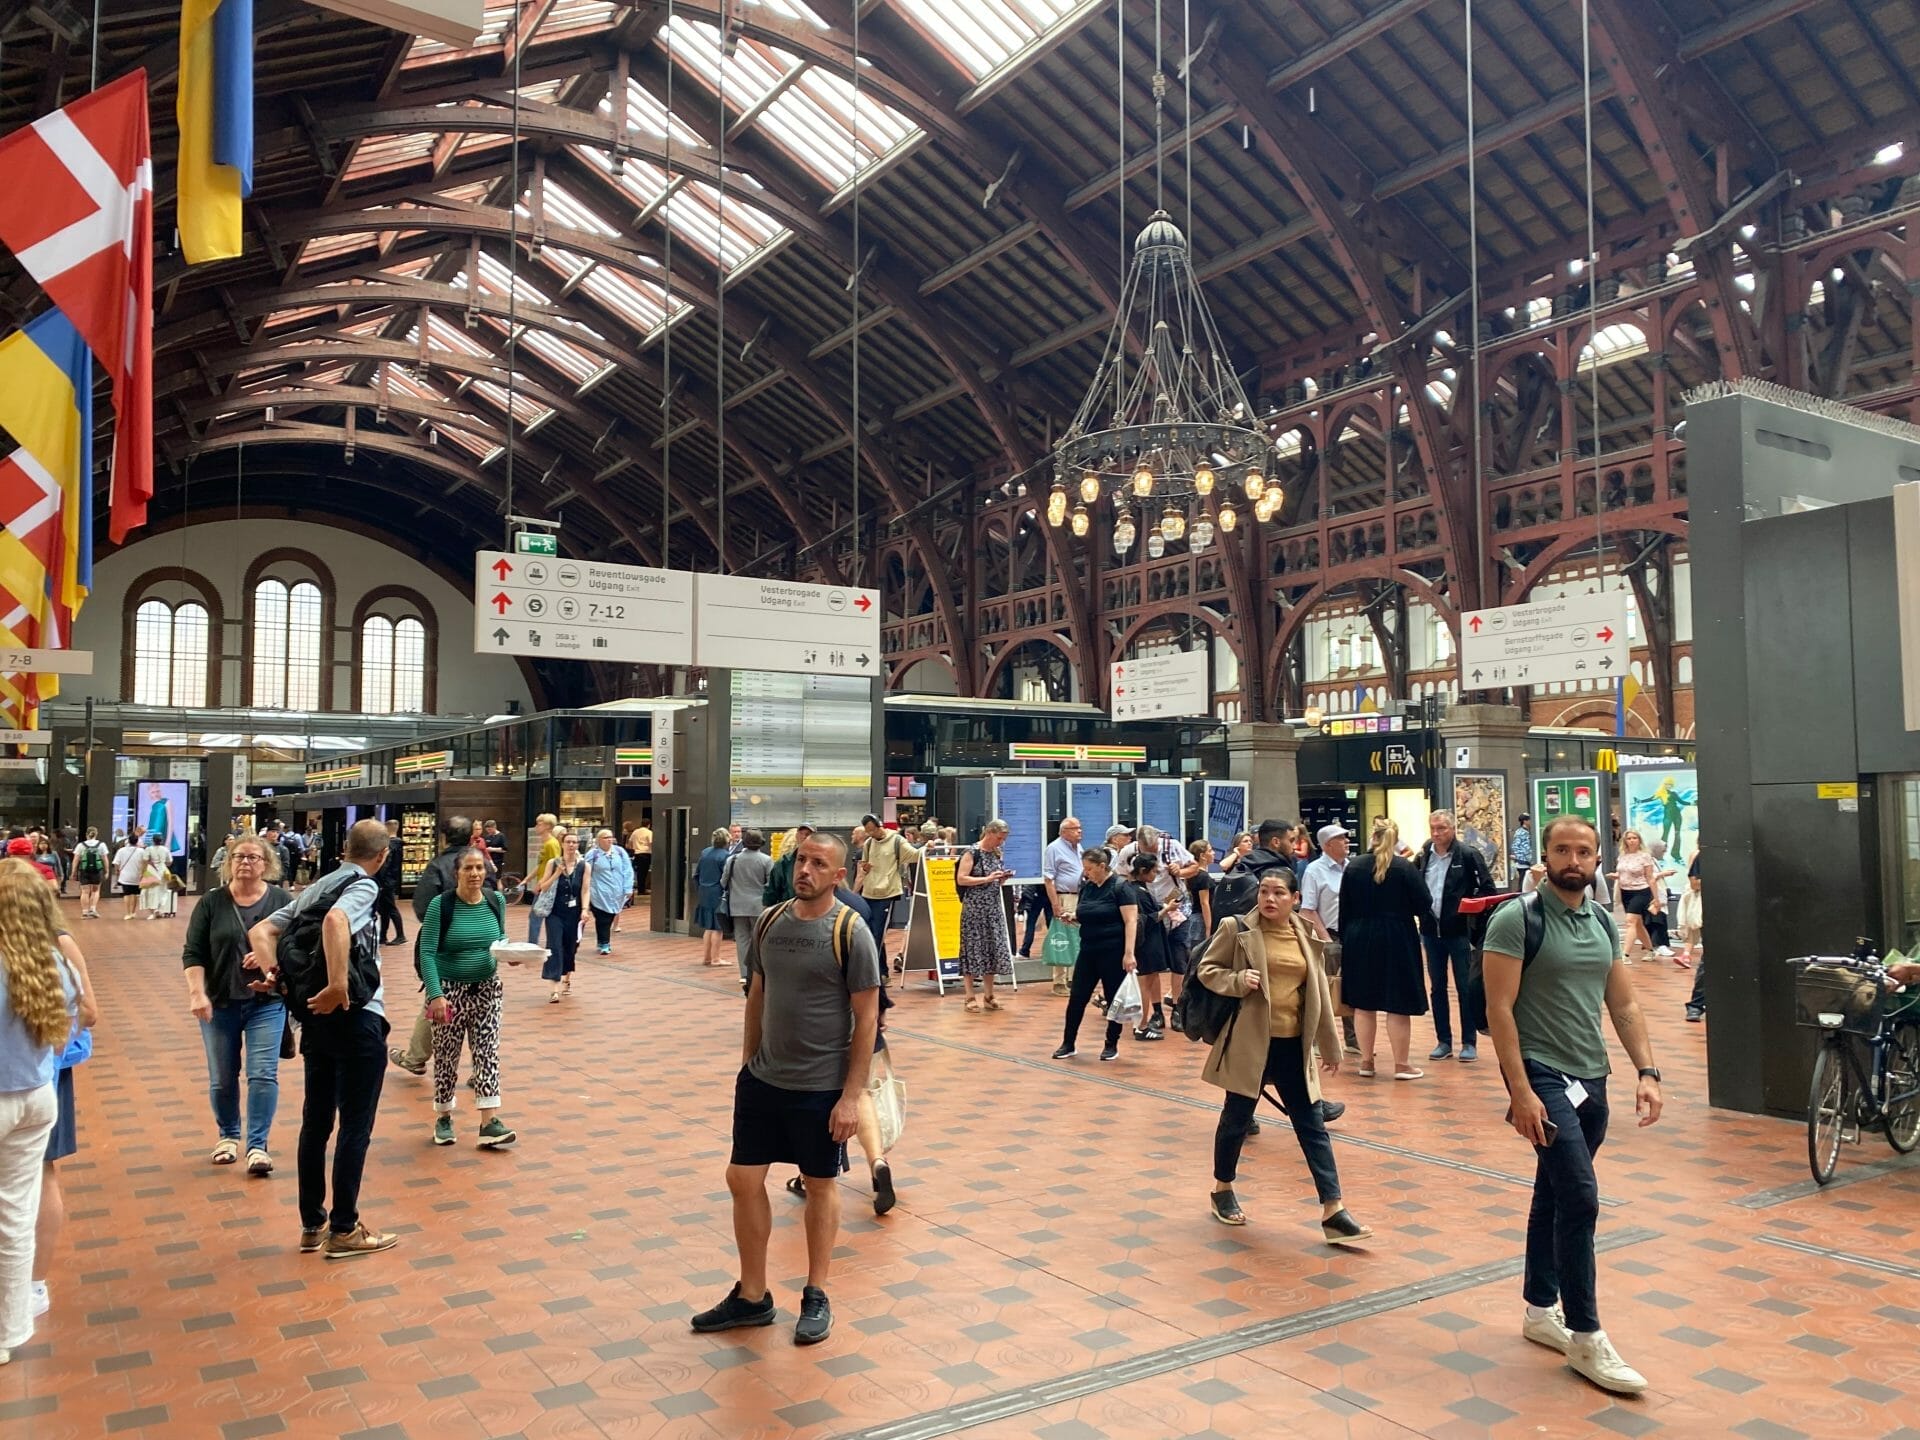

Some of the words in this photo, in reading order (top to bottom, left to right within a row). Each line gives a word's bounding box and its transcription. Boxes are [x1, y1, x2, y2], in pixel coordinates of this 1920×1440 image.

[589, 568, 666, 584] Reventlowsgade
[589, 580, 625, 592] Udgang
[760, 585, 821, 598] Vesterbrogade
[760, 596, 792, 607] Udgang
[588, 603, 625, 619] 7-12
[1512, 604, 1566, 617] Vesterbrogade
[1512, 617, 1540, 627] Udgang
[9, 655, 32, 665] 7-8
[661, 718, 667, 726] 7
[661, 738, 667, 746] 8
